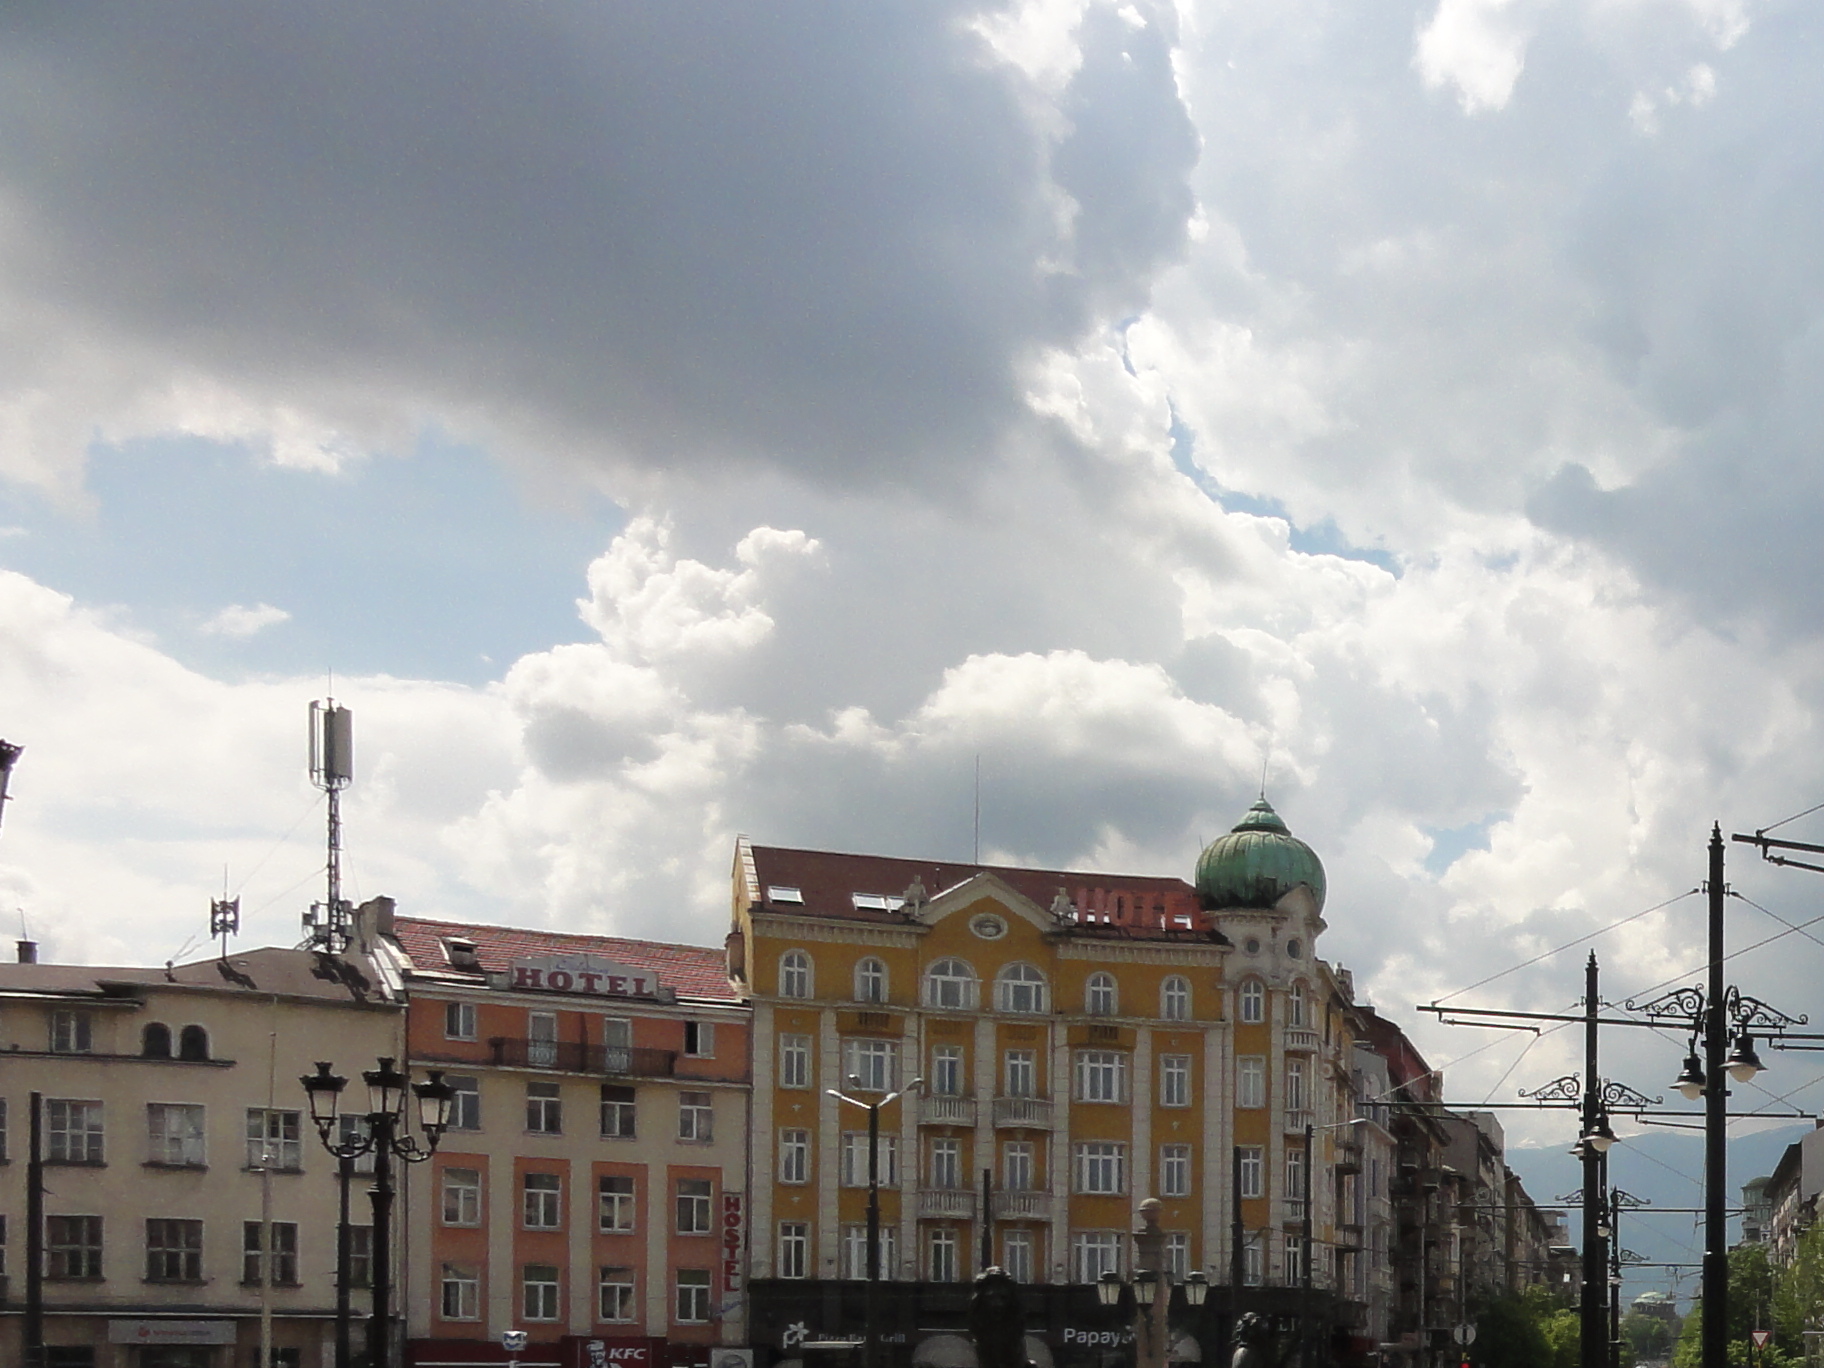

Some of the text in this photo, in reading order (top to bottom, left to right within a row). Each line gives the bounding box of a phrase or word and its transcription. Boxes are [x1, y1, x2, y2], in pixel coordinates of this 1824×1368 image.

[514, 967, 655, 996] HOTEL
[724, 1196, 741, 1292] HOSTEL
[608, 1347, 647, 1360] KFC
